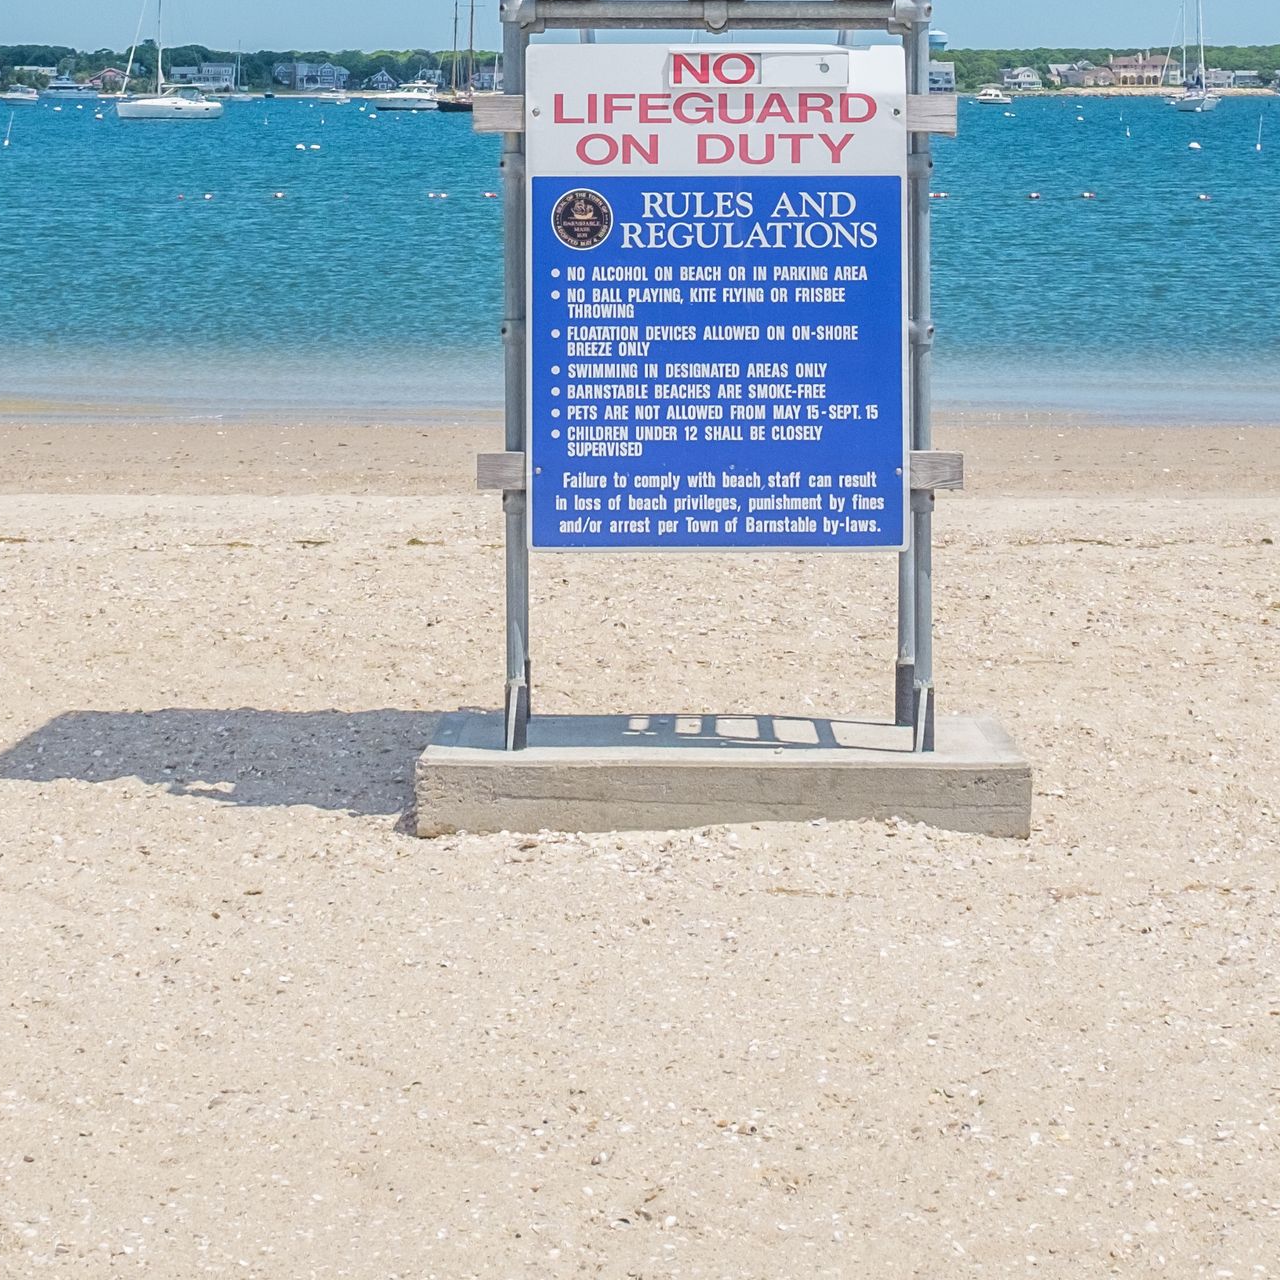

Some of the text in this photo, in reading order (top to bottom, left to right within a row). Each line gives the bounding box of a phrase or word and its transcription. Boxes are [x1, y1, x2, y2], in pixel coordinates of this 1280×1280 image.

[673, 53, 756, 85] NO
[554, 92, 878, 124] LIFEGUARD
[575, 133, 855, 165] ON DUTY
[588, 193, 603, 206] TOWN
[641, 191, 856, 218] RULES AND
[620, 222, 878, 250] REGULATIONS
[567, 265, 868, 282] NO ALCOHOL ON BEACH OR IN PARKING AREA
[567, 287, 846, 305] NO BALL PLAYING, KITE FLYING OR FRISBEE
[567, 303, 635, 319] THROWING
[567, 325, 859, 341] FLOATATION DEVICES ALLOWED ON ON-SHORE
[567, 341, 651, 357] BREEZE ONLY
[567, 362, 828, 379] SWIMMING IN DESIGNATED AREAS ONLY
[567, 383, 826, 400] BARNSTABLE BEACHES ARE SMOKE-FREE
[567, 404, 598, 421] PETS
[603, 404, 629, 421] ARE
[634, 404, 661, 421] NOT
[666, 404, 724, 421] ALLOWED
[730, 404, 766, 421] FROM
[772, 404, 802, 420] MAY
[865, 404, 879, 420] 15
[567, 425, 824, 442] CHILDREN UNDER 12 SHALL BE CLOSELY
[567, 441, 643, 457] SUPERVISED
[562, 471, 877, 491] Failure to comply with beach staff can result
[555, 493, 885, 514] in loss of beach privileges, punishment by fines
[559, 516, 882, 536] and/or arrest per Town of Barnstable by-laws.
